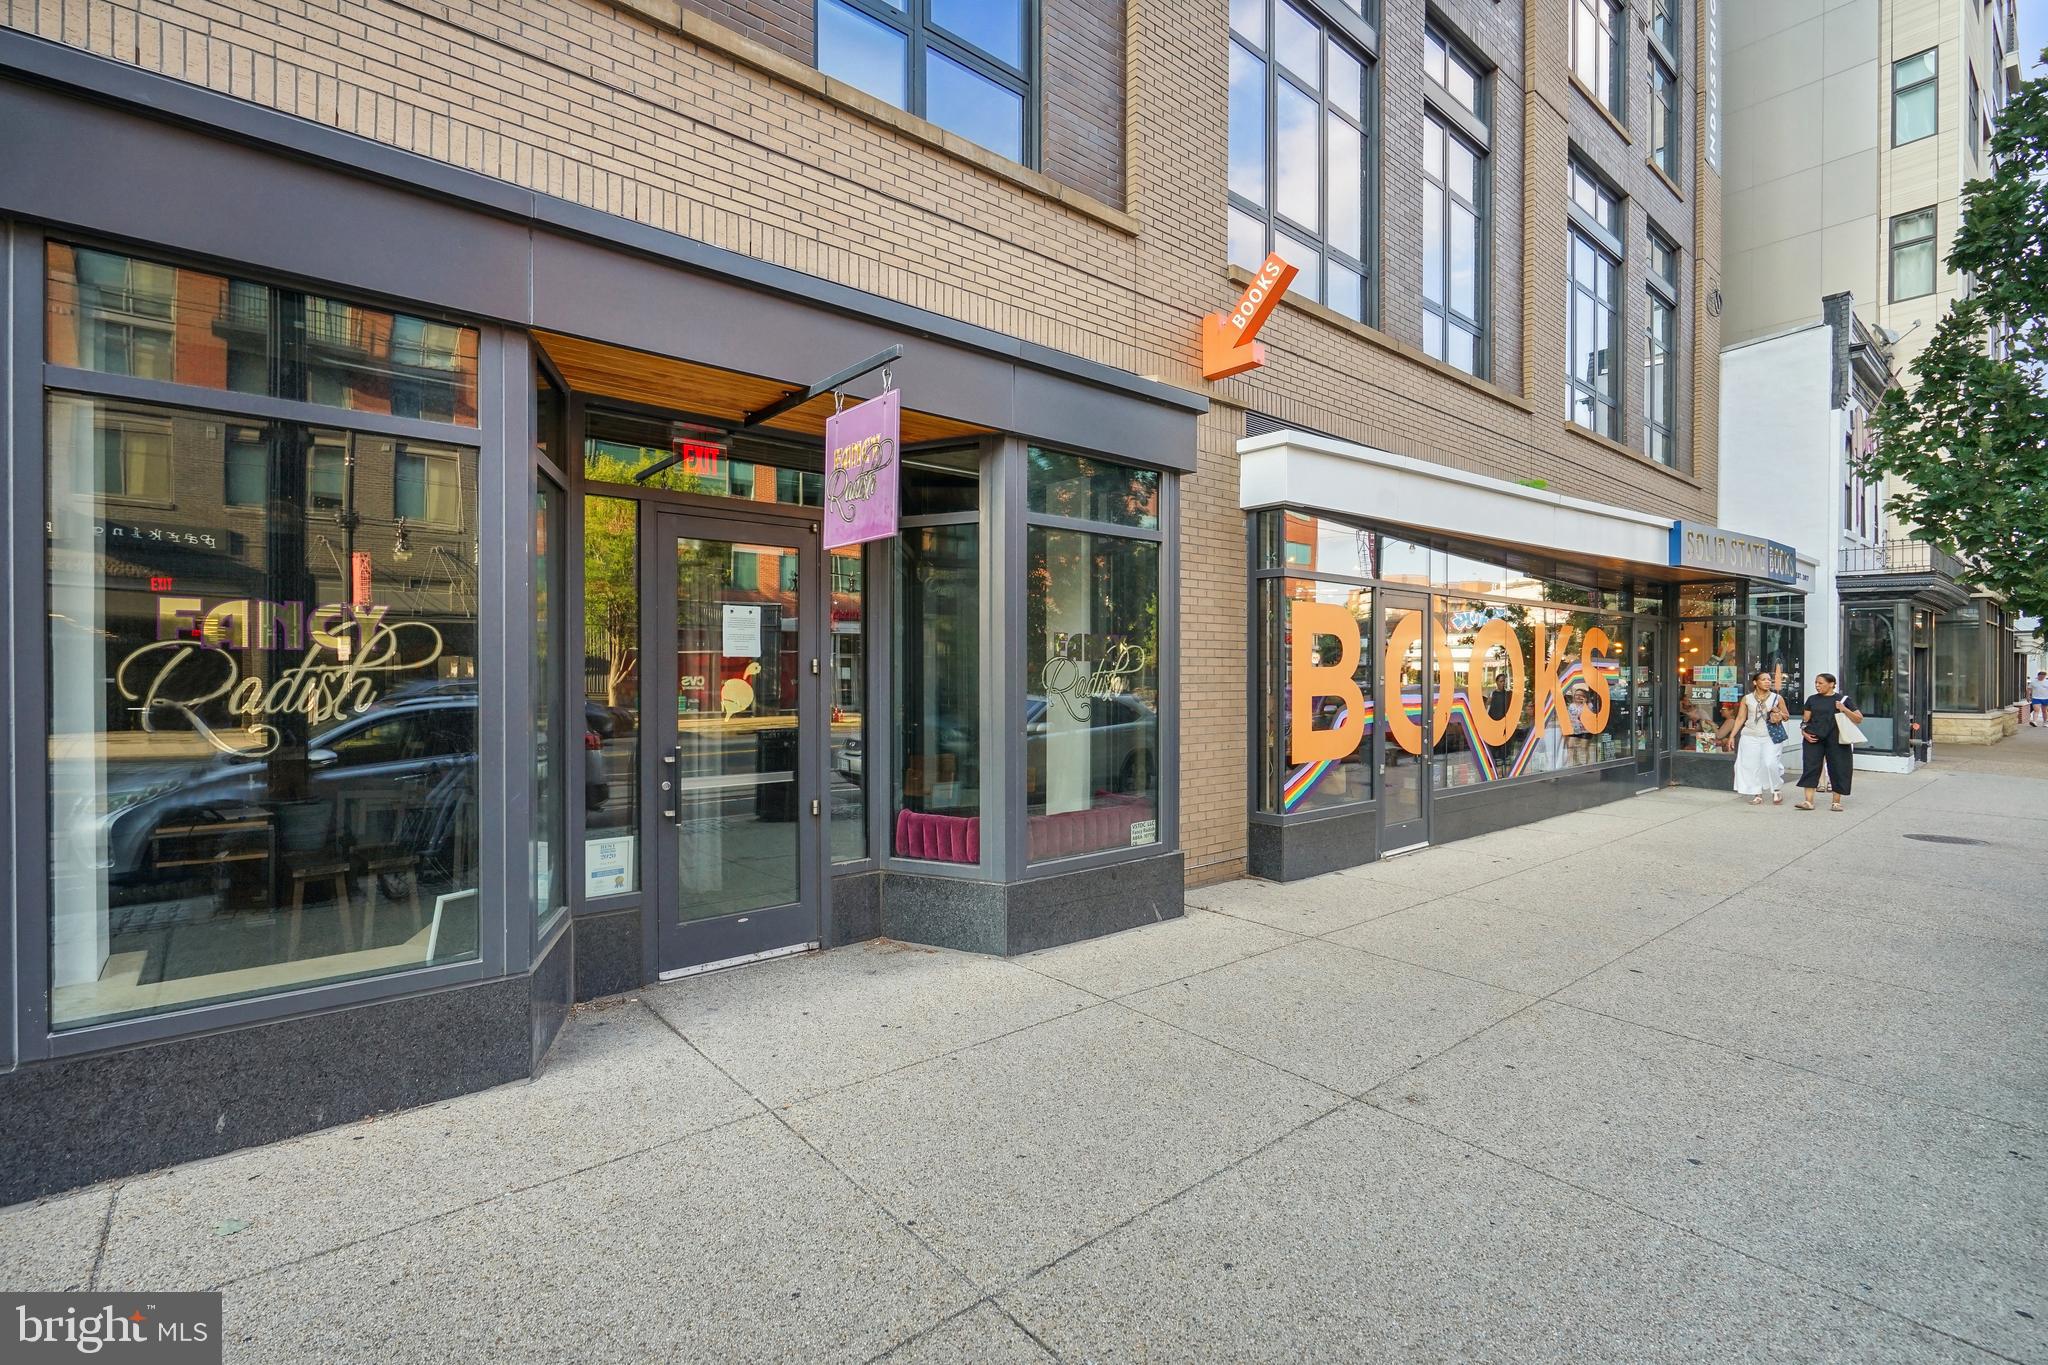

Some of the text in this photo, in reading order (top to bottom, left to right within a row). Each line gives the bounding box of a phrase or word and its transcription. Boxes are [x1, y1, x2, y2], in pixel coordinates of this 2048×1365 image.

[1231, 262, 1280, 330] BOOKS
[683, 444, 720, 477] EXIT
[826, 438, 895, 523] Radish
[833, 432, 882, 471] FANCY
[1687, 530, 1795, 577] SOLID STATE BOOKS
[150, 577, 173, 592] EXIT
[156, 595, 390, 650] FANCY
[116, 621, 443, 758] Radish
[1041, 643, 1145, 723] Radish
[1292, 600, 1611, 765] BOOKS
